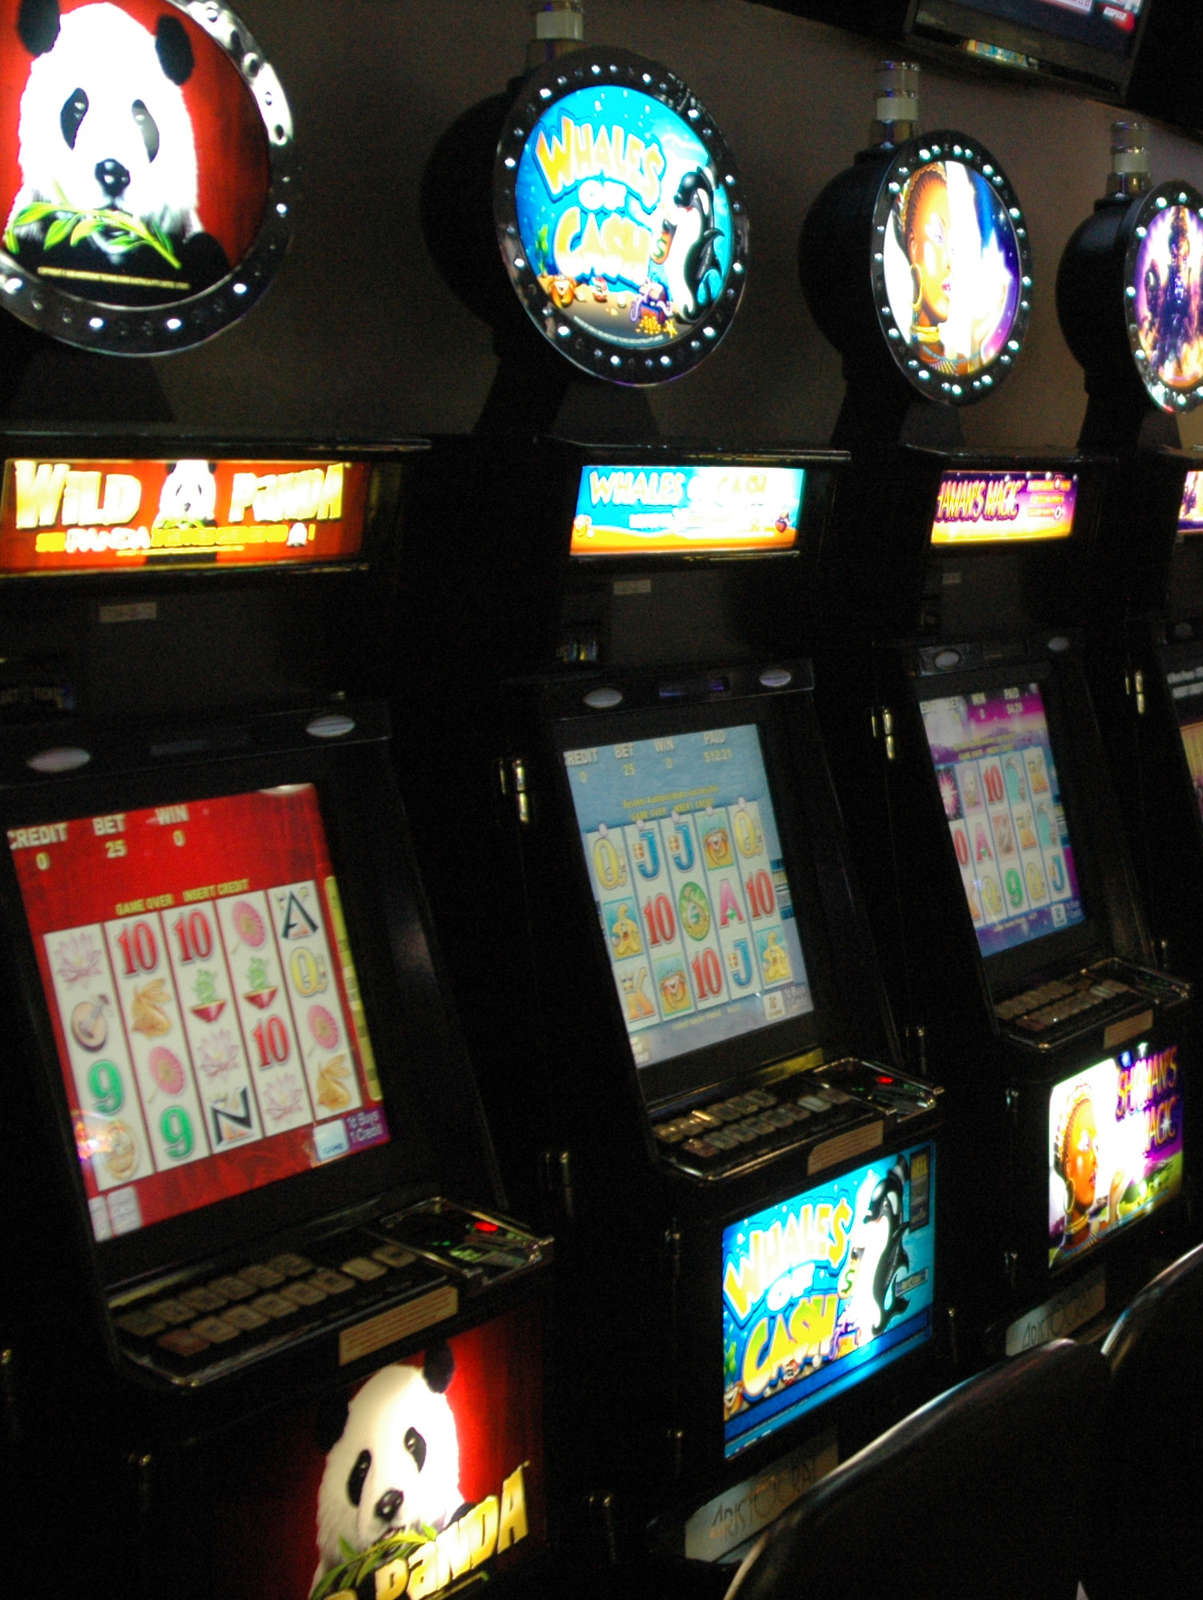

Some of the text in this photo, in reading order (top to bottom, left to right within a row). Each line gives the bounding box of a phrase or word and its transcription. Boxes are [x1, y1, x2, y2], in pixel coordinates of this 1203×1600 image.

[589, 470, 686, 506] WHALES
[564, 749, 598, 767] REDIT
[983, 765, 1004, 804] 10
[92, 813, 126, 836] BET
[155, 804, 189, 825] WIN
[36, 829, 186, 871] 0 25 0
[592, 838, 627, 890] Q
[634, 830, 660, 879] J
[670, 823, 695, 872] J
[643, 869, 776, 946] 10 A 10
[1005, 867, 1024, 908] 9
[117, 890, 320, 977] 10 10 A
[290, 947, 326, 998] Q
[692, 948, 723, 1000] 10
[729, 939, 753, 987] J
[253, 1015, 290, 1070] 10
[88, 1060, 124, 1116] 9
[160, 1086, 254, 1160] 9 N
